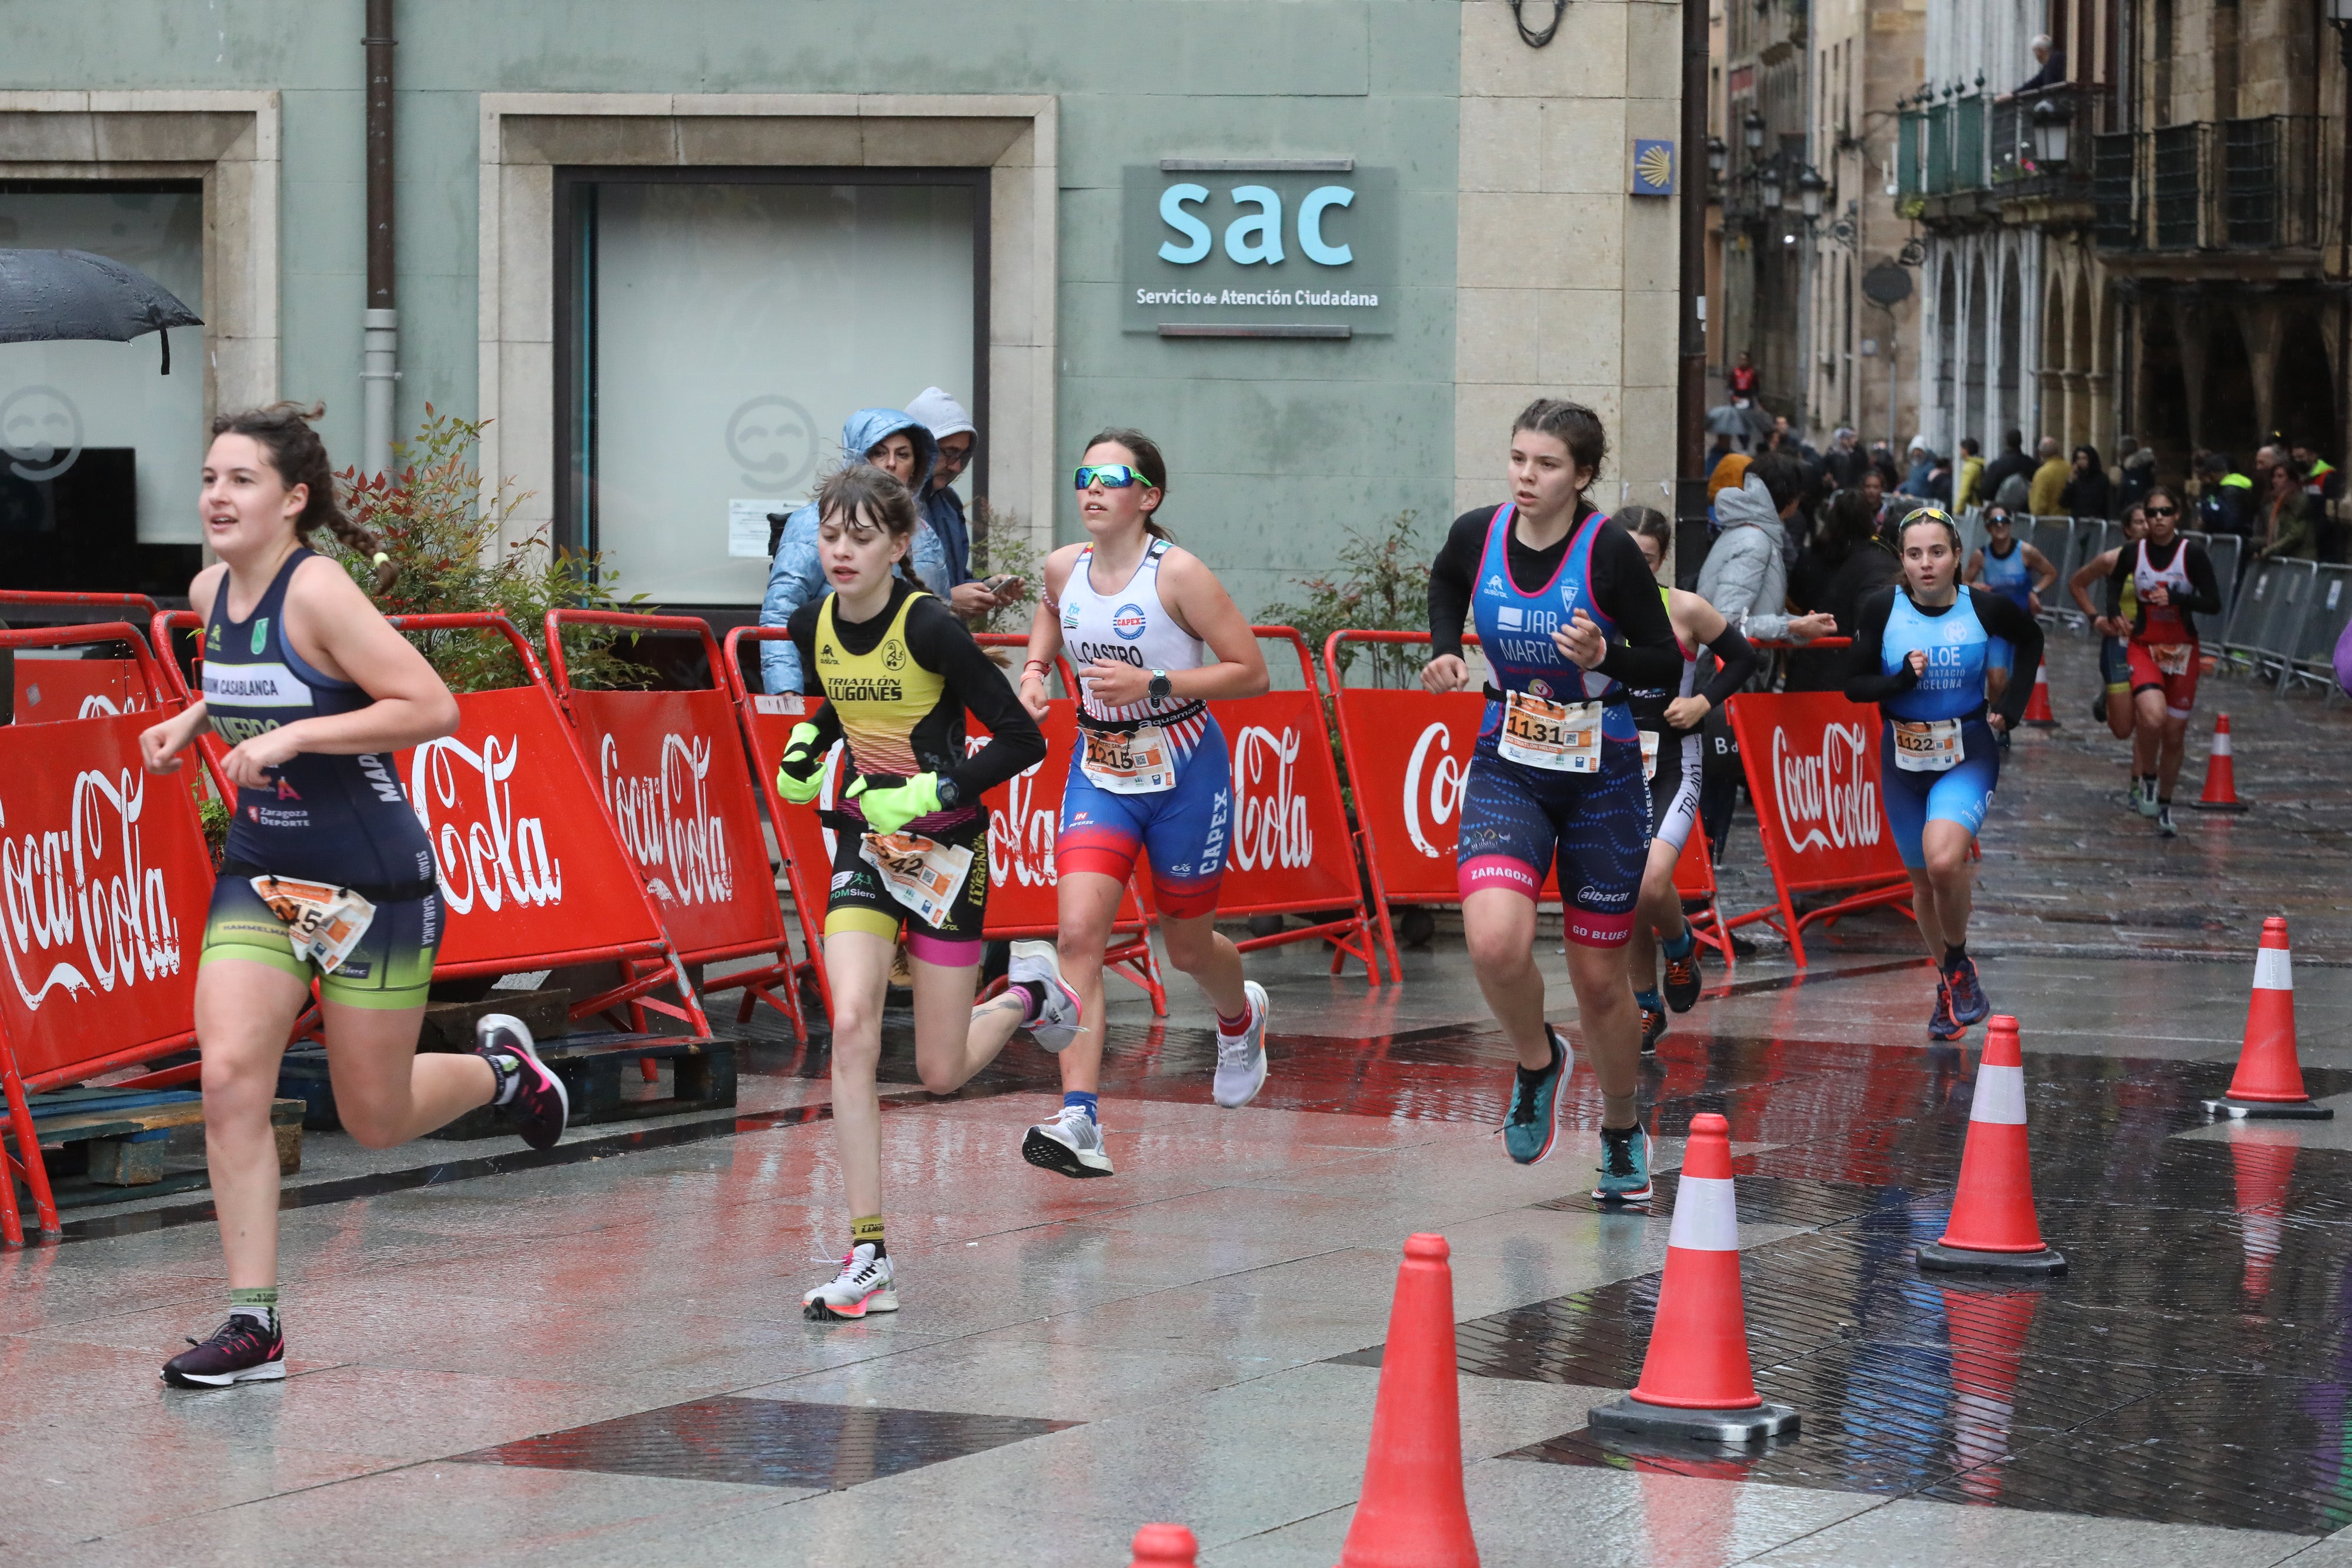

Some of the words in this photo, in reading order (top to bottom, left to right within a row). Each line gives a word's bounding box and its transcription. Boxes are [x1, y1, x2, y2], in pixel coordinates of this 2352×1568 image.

[1158, 183, 1355, 265] sac
[1136, 289, 1201, 305] Servicio
[1202, 292, 1217, 305] de
[1221, 289, 1291, 306] Atención
[1295, 290, 1378, 306] Ciudadana
[1117, 617, 1141, 626] CAPEX
[1524, 610, 1558, 635] JAB
[1499, 638, 1561, 665] MARTA
[1925, 647, 1961, 667] LOE
[220, 680, 279, 696] CASABLANCA
[828, 675, 901, 686] TRIATLÓN
[1916, 678, 1962, 690] RCELONA
[828, 686, 902, 701] LUGONES
[1506, 716, 1564, 745] 1131
[1898, 735, 1934, 751] 1122
[1086, 744, 1134, 769] 1215
[357, 753, 402, 802] MAP
[1772, 722, 1880, 854] Coca-Cola
[260, 807, 308, 818] Zaragoza
[260, 817, 310, 827] DEPORTE
[1199, 787, 1228, 875] CAPEX
[1471, 867, 1534, 888] ZARAGOZA
[830, 888, 876, 901] PDMSiero
[1579, 887, 1630, 902] albacar
[421, 895, 436, 945] ASABLANCA
[1572, 925, 1588, 937] GO
[1591, 929, 1628, 941] BLUES
